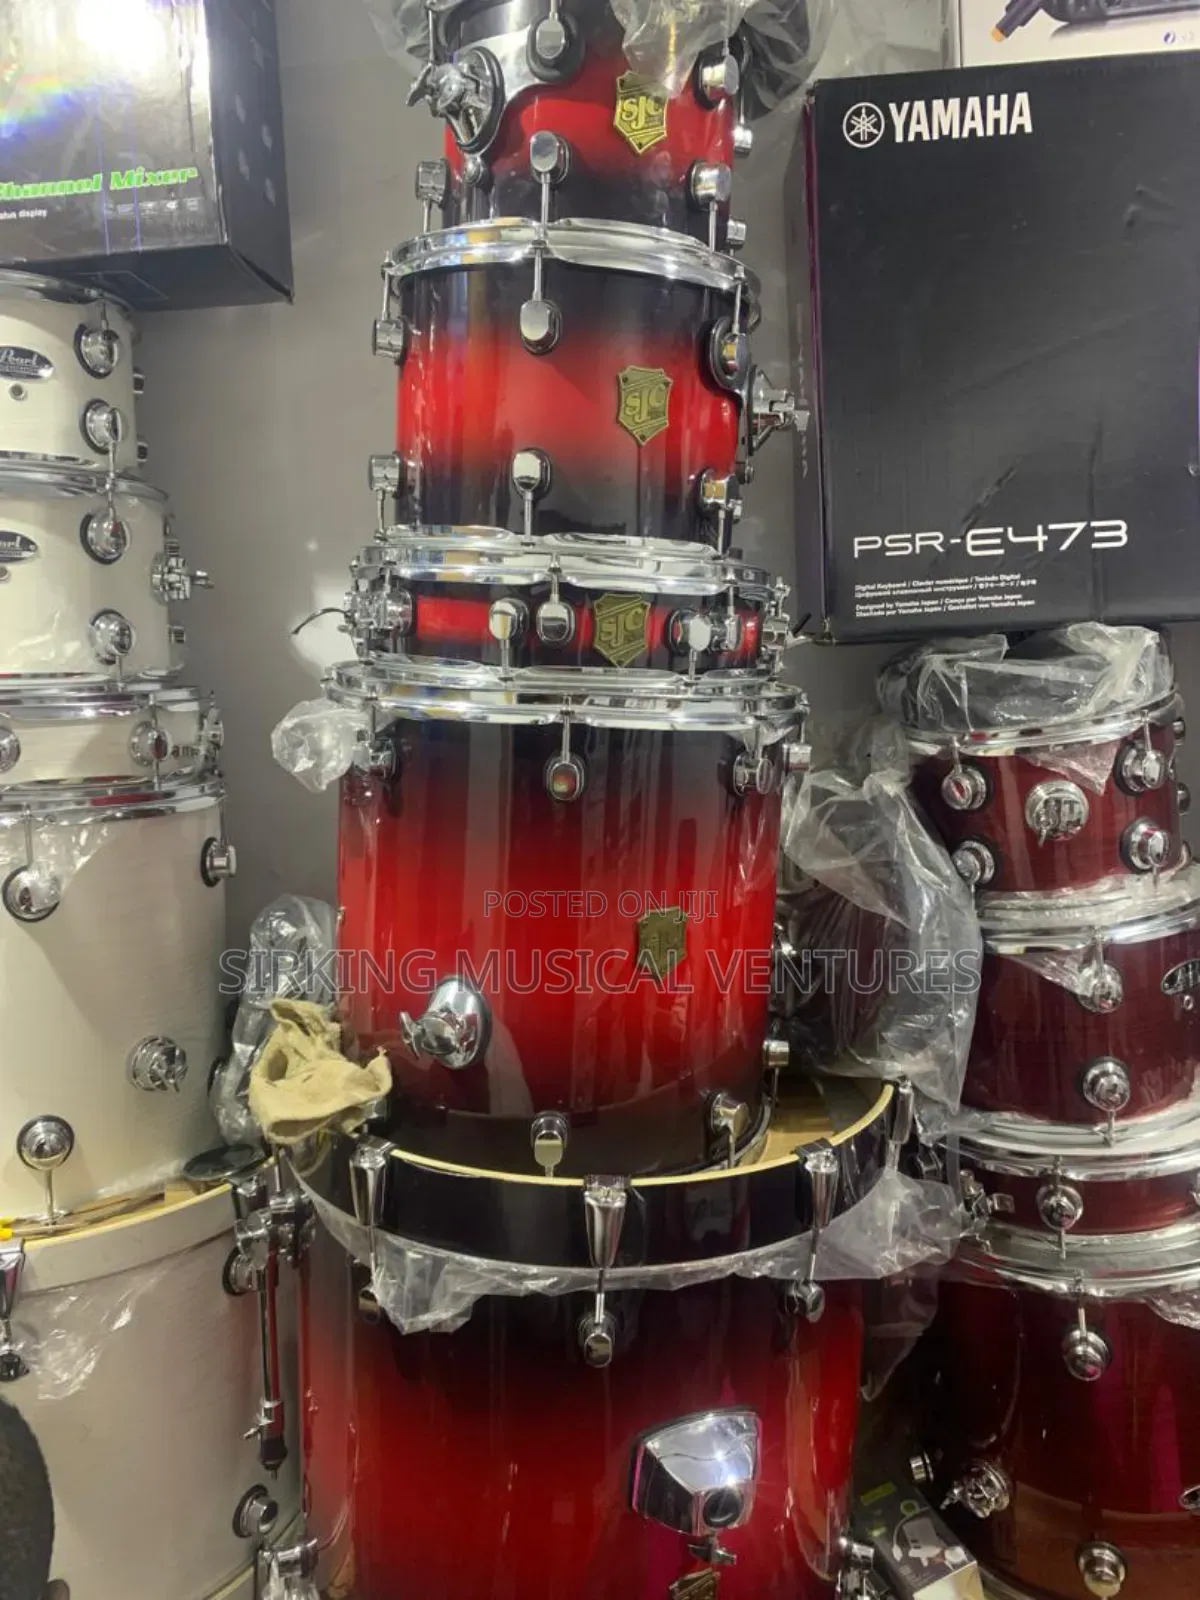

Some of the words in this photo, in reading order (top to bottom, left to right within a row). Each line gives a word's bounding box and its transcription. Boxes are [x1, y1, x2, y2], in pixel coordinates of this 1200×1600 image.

[889, 92, 1033, 142] YAMAHA
[109, 166, 198, 190] Mixer
[624, 384, 666, 423] SJC
[853, 519, 1128, 558] PSR-E473
